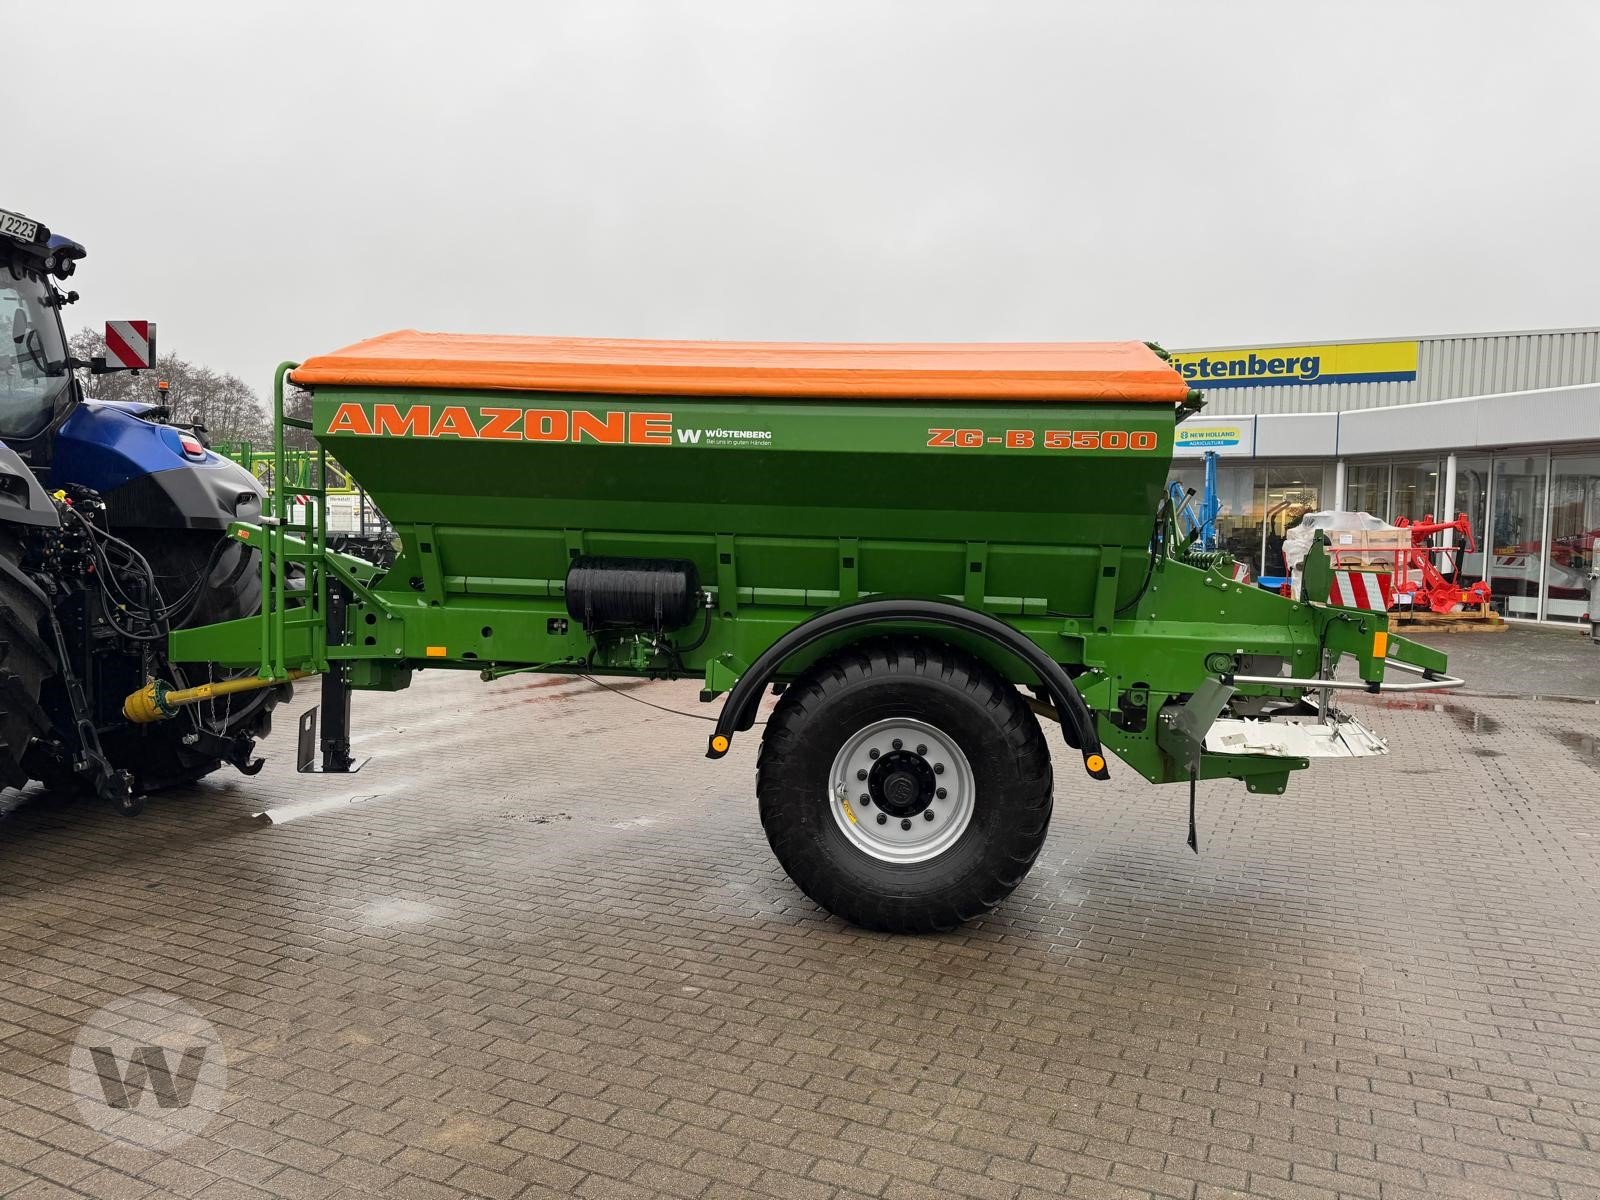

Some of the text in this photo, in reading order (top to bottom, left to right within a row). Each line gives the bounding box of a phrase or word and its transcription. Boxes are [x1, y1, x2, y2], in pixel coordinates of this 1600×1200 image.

[5, 217, 36, 238] 2223
[1168, 354, 1320, 379] stenberg
[326, 402, 673, 445] AMAZONE
[705, 428, 772, 439] WÜSTENBERG
[677, 429, 702, 444] W
[926, 428, 1158, 451] ZG-B 5500
